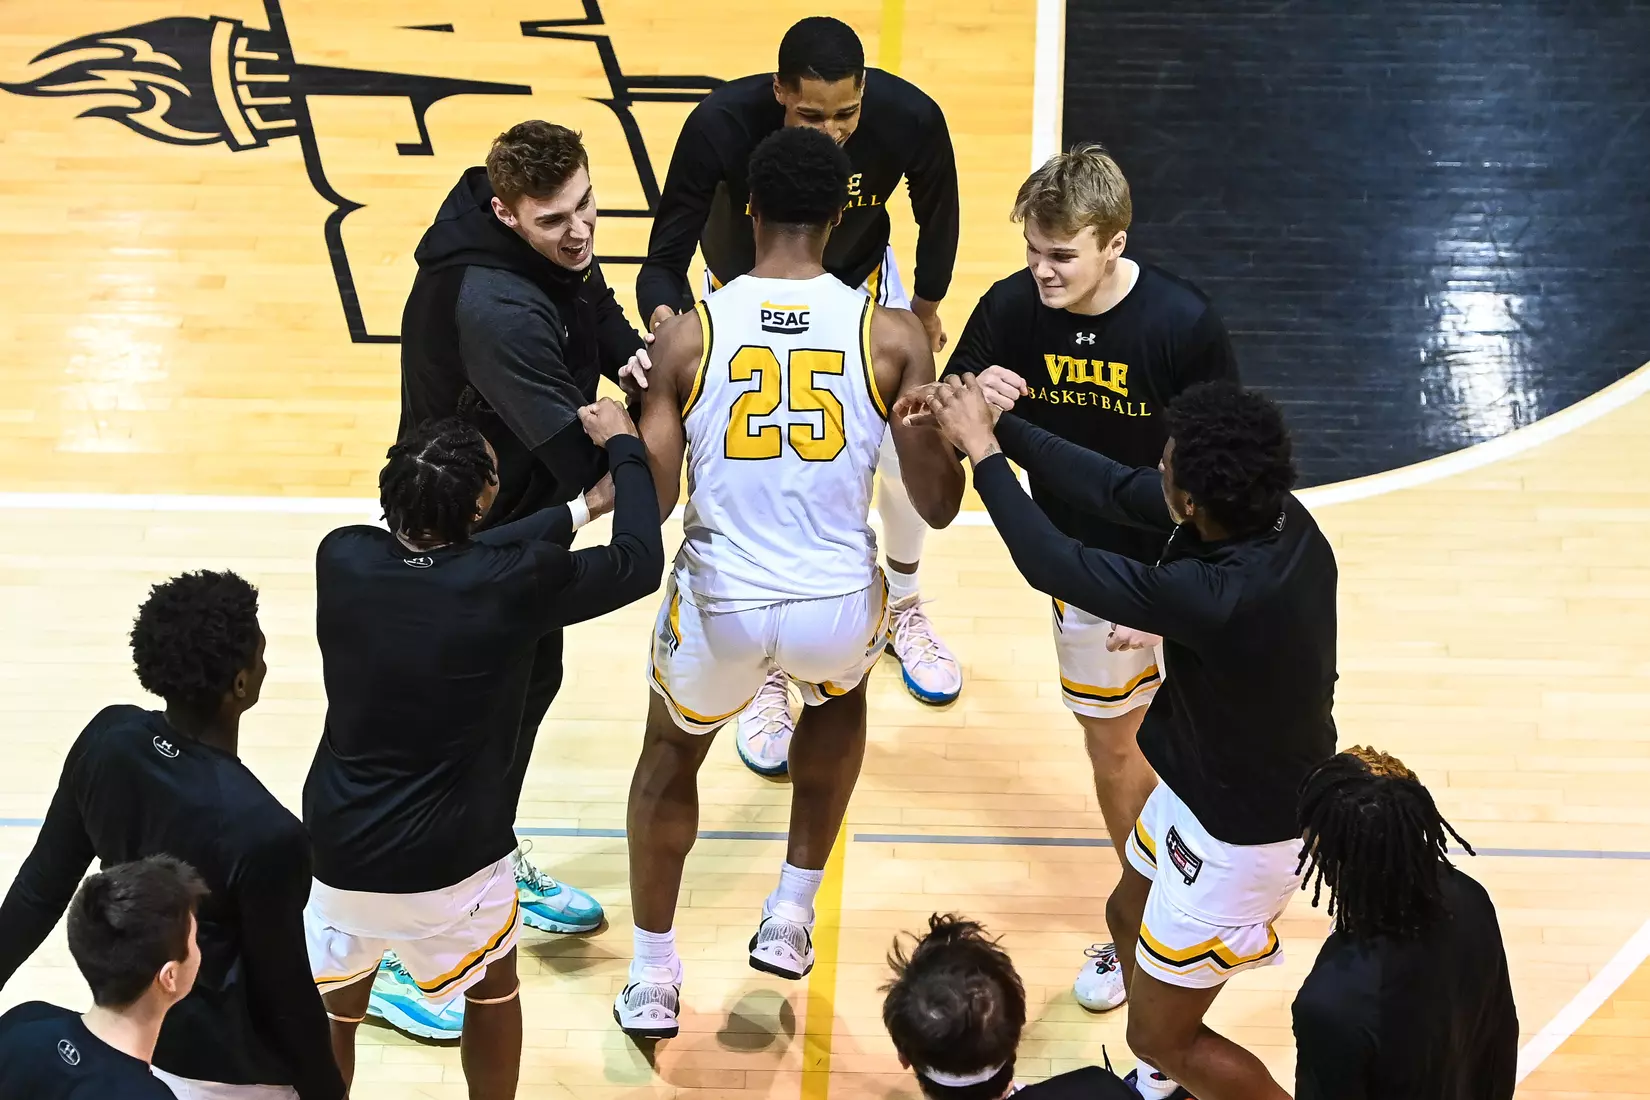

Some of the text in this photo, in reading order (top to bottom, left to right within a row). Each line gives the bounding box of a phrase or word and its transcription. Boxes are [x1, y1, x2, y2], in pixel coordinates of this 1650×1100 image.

[760, 309, 810, 326] PSAC
[1043, 353, 1129, 398] VILLE
[724, 345, 847, 462] 25
[1027, 386, 1152, 417] BASKETBALL
